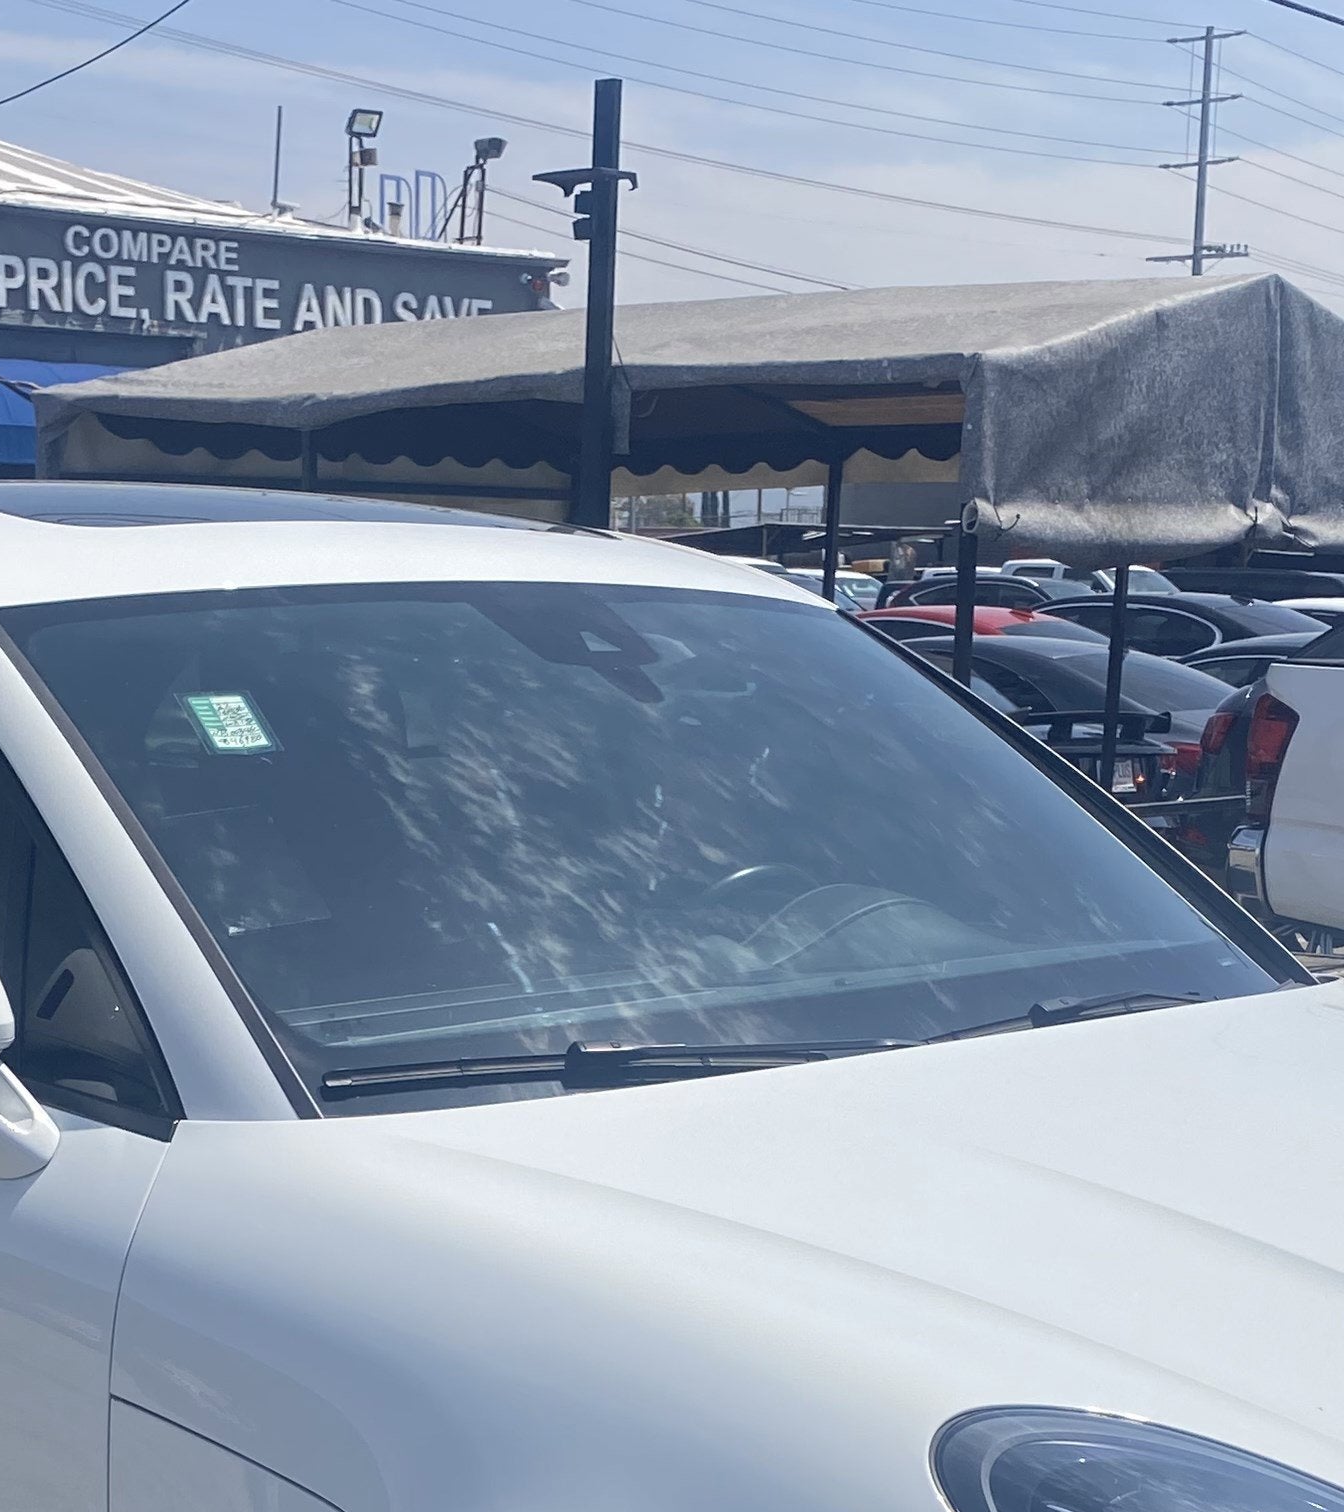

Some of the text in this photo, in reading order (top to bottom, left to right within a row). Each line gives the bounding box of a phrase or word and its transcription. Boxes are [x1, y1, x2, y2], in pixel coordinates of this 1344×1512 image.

[65, 225, 240, 271] COMPARE
[163, 270, 282, 330] RATE
[293, 283, 384, 331] AND
